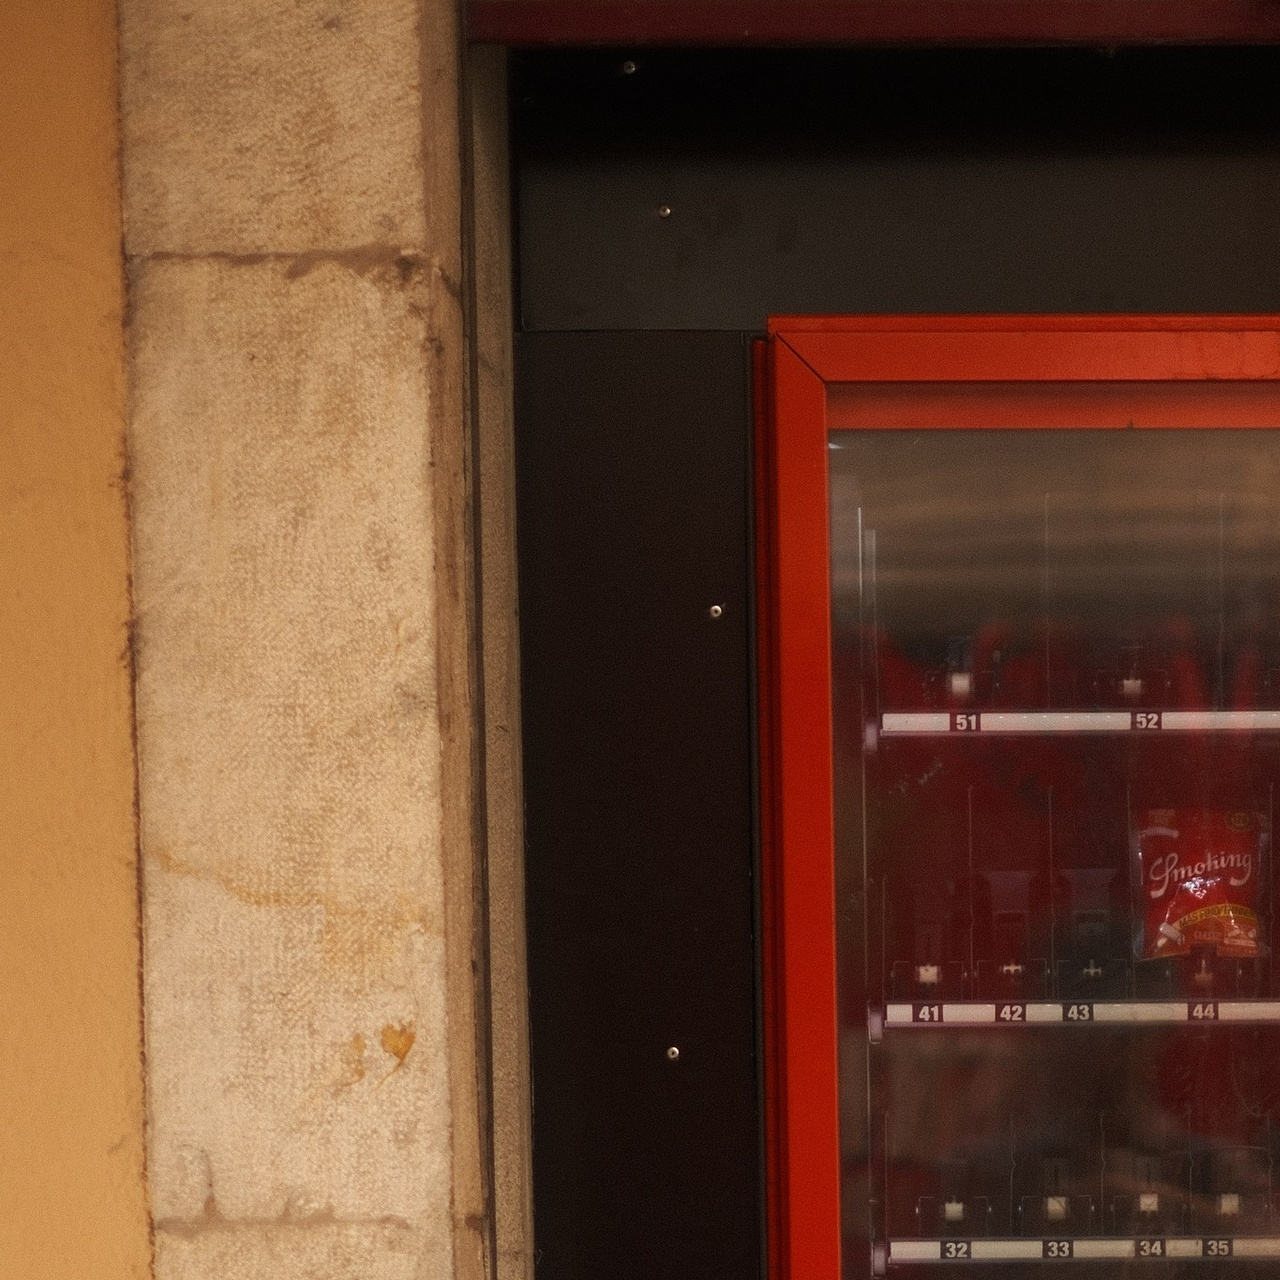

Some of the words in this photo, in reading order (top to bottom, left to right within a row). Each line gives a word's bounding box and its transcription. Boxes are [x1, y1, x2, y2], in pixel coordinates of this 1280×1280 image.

[956, 714, 977, 730] 51
[1136, 713, 1158, 728] 52
[1150, 851, 1251, 898] Smoking
[919, 1006, 939, 1021] 41
[1000, 1006, 1022, 1021] 42
[1068, 1005, 1090, 1020] 43
[1193, 1005, 1214, 1019] 44
[946, 1243, 967, 1258] 32
[1048, 1242, 1069, 1257] 33
[1140, 1241, 1161, 1256] 34
[1207, 1241, 1229, 1255] 35
